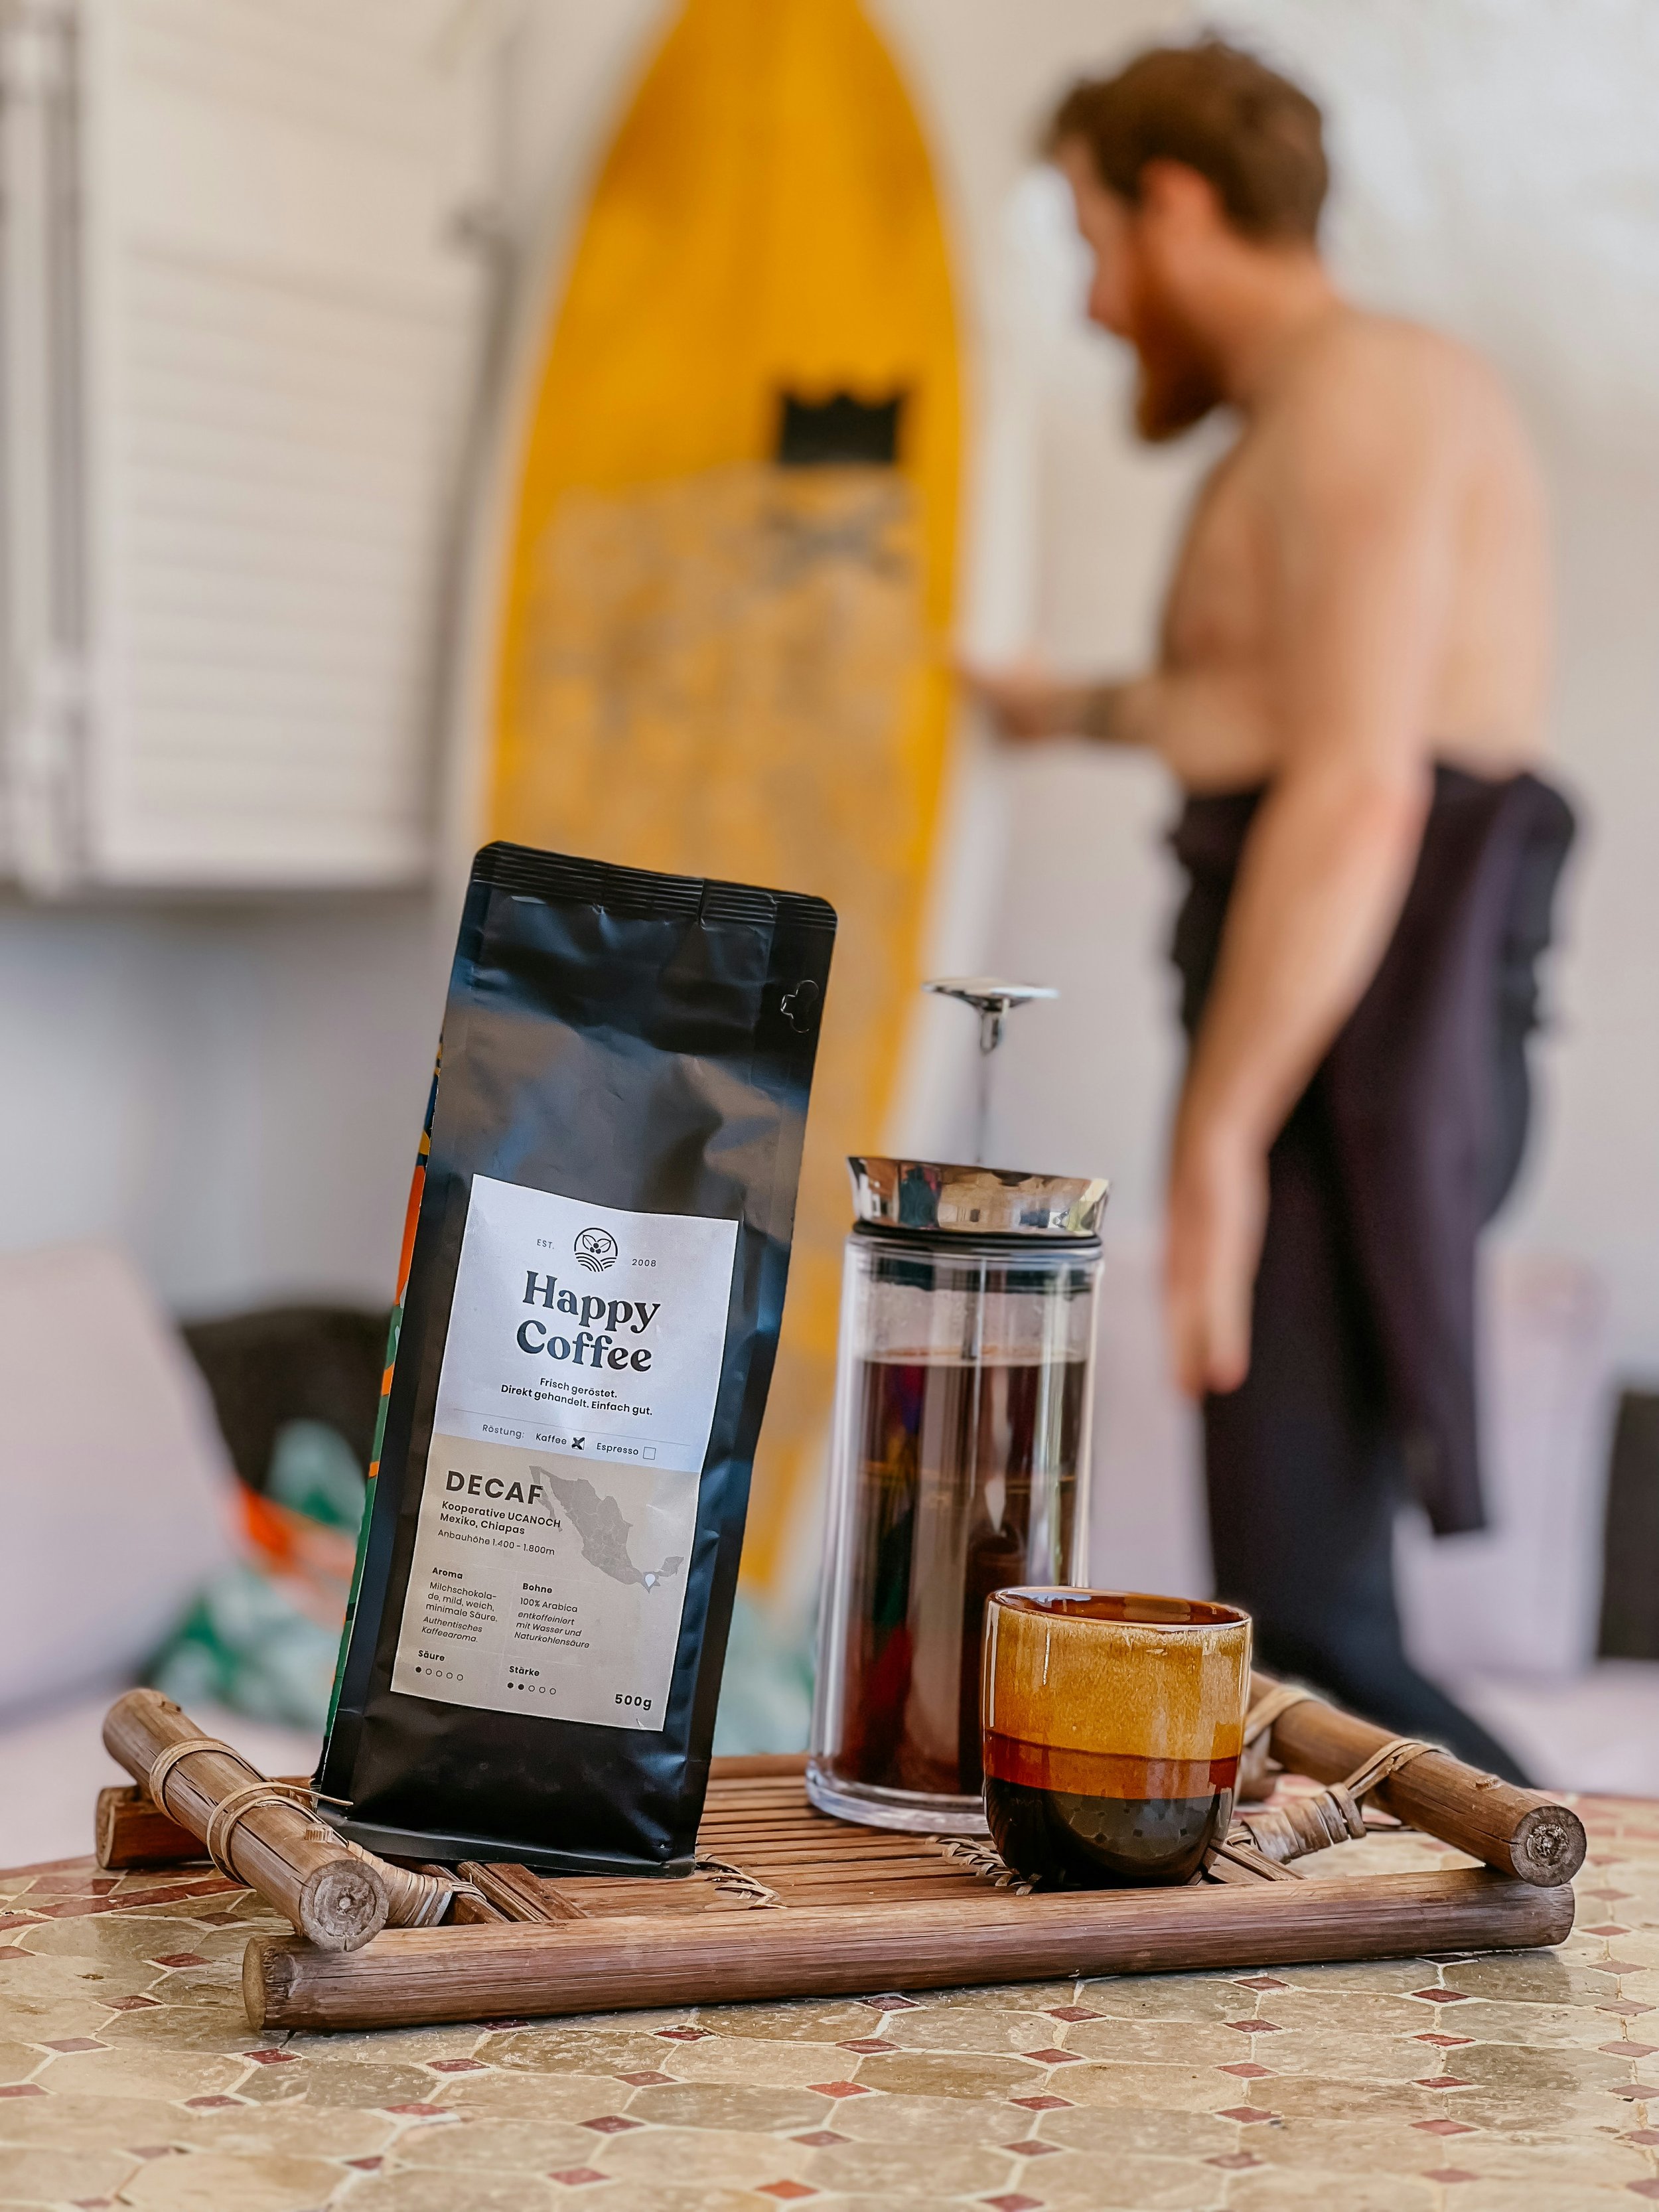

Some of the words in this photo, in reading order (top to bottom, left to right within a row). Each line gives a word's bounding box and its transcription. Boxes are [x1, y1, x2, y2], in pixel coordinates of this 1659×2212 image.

[537, 1238, 554, 1250] EST.
[631, 1258, 656, 1267] 2008
[522, 1270, 660, 1334] Happy
[516, 1320, 652, 1372] Coffee
[540, 1378, 569, 1390] Frisch
[571, 1385, 617, 1398] geröstet.
[501, 1384, 532, 1397] Direkt
[534, 1391, 589, 1408] gehandelt.
[591, 1402, 630, 1412] Einfach
[632, 1406, 652, 1416] gut.
[482, 1425, 524, 1439] Röstung:
[536, 1434, 567, 1445] Kaffee
[597, 1443, 638, 1455] Espresso
[446, 1471, 543, 1505] DECAF
[442, 1501, 505, 1518] Kooperative
[508, 1512, 561, 1527] UCANOCH
[440, 1513, 478, 1528] Mexiko,
[480, 1520, 525, 1534] Chiapas
[438, 1530, 490, 1545] Anbauhöhe
[492, 1538, 514, 1549] 1.400
[524, 1544, 555, 1555] 1.800m
[433, 1568, 463, 1579] Aroma
[430, 1582, 496, 1599] Milchschokola-
[523, 1583, 552, 1593] Bohne
[428, 1593, 440, 1602] de,
[443, 1595, 464, 1607] mild,
[466, 1599, 494, 1611] weich,
[520, 1597, 540, 1607] 100%
[542, 1601, 577, 1613] Arabica
[425, 1603, 467, 1617] minimale
[470, 1611, 498, 1621] Säure.
[518, 1611, 575, 1625] entkoffeiniert
[423, 1616, 482, 1633] Authentisches
[532, 1624, 563, 1634] Wasser
[565, 1628, 581, 1637] und
[421, 1626, 478, 1643] Kaffeearoma.
[514, 1631, 589, 1649] Naturkohlensäure
[418, 1650, 445, 1661] Säure
[510, 1666, 540, 1676] Stärke
[614, 1693, 652, 1710] 500g
